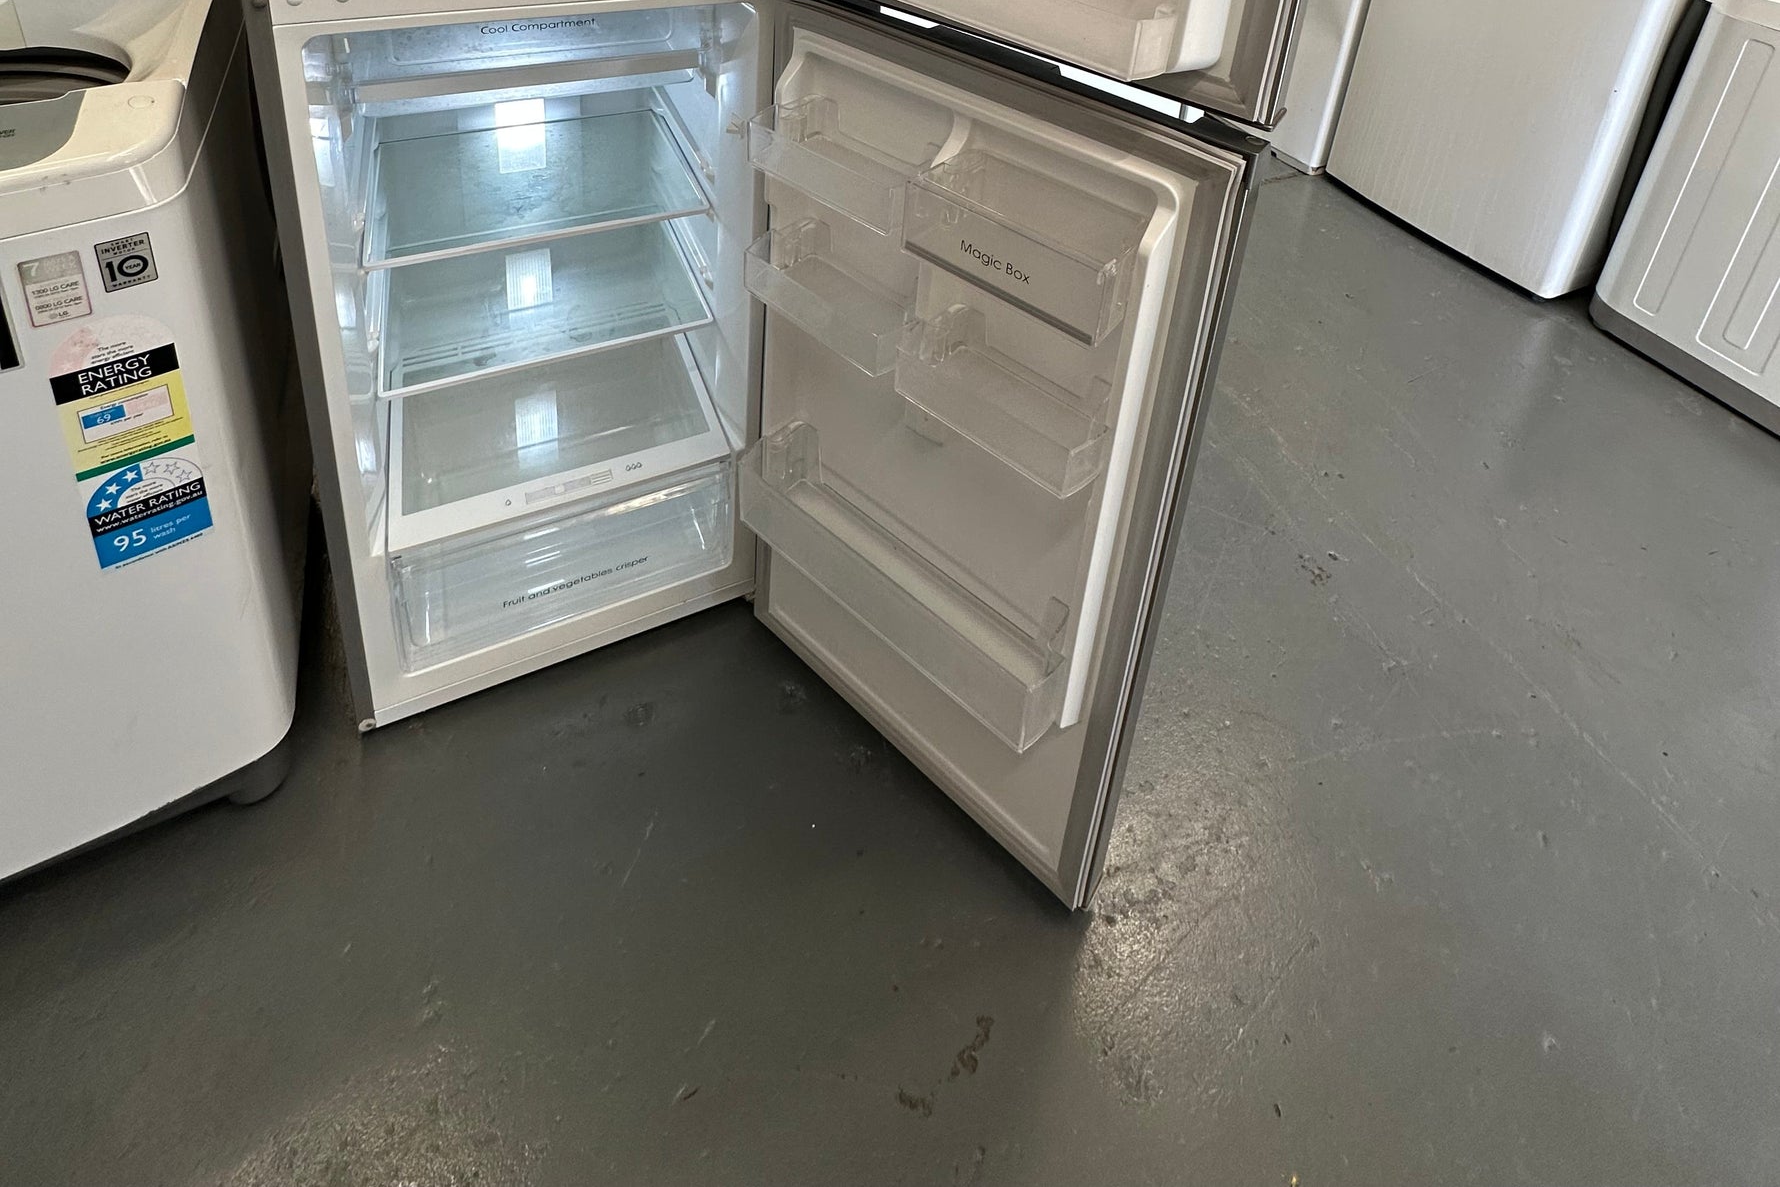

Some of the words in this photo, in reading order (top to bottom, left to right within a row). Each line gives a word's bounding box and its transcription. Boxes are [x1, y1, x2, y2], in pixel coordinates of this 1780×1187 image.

[480, 25, 508, 35] Cool
[511, 18, 595, 32] Compartment
[101, 239, 145, 254] INVERTER
[23, 262, 39, 276] 7
[105, 255, 149, 282] 10
[960, 239, 1002, 271] Magic
[1005, 263, 1031, 285] Box
[60, 281, 79, 289] CARE
[78, 354, 150, 384] ENERGY
[81, 366, 152, 396] RATING
[97, 413, 111, 424] 69
[94, 502, 146, 525] WATER
[149, 481, 201, 507] RATING
[113, 528, 147, 552] 95
[150, 521, 174, 533] litres
[176, 514, 191, 525] per
[153, 527, 176, 539] wash
[503, 595, 526, 608] Fruit
[528, 588, 550, 600] and
[552, 568, 613, 591] vegetables
[616, 556, 648, 571] crisper
